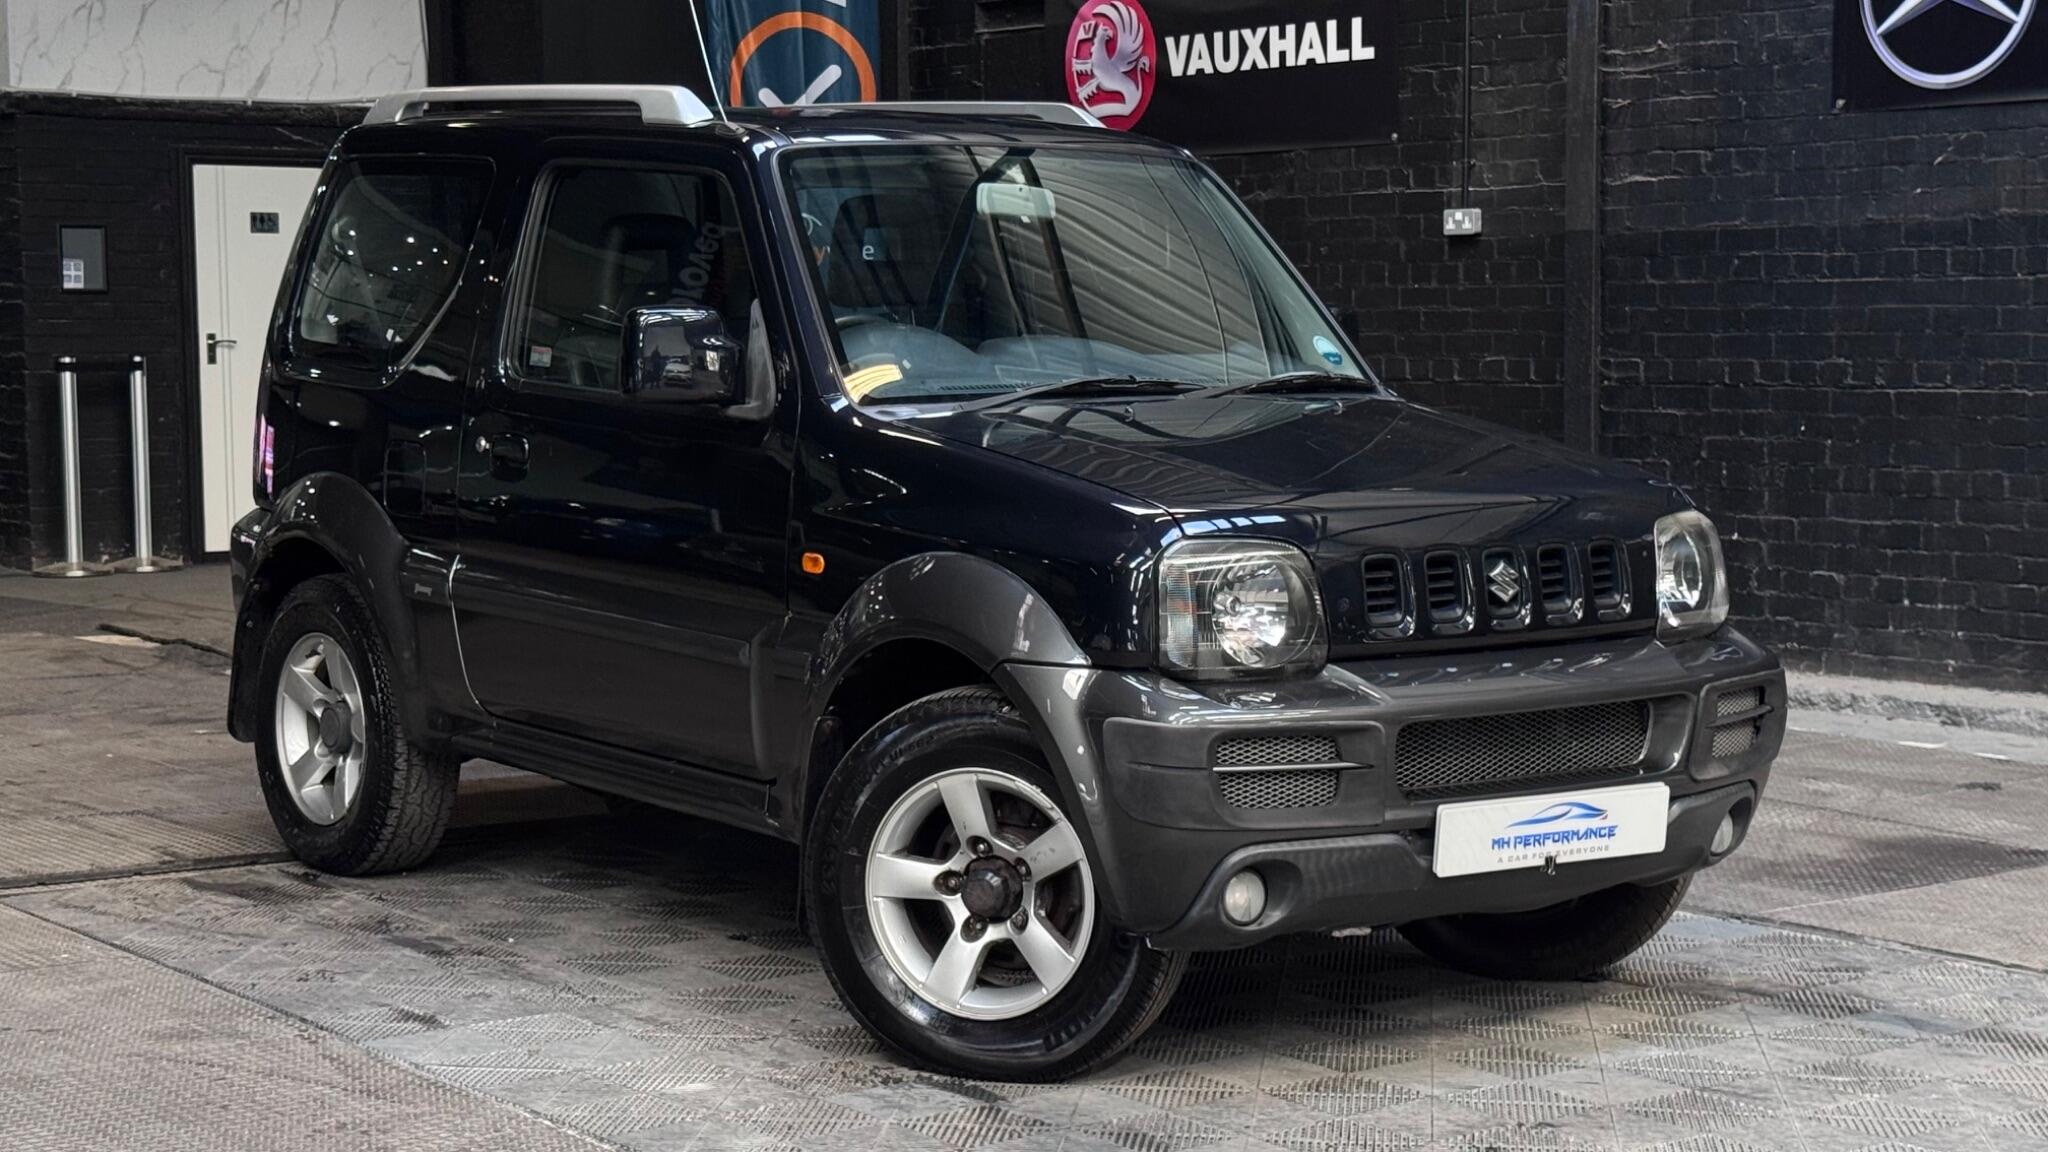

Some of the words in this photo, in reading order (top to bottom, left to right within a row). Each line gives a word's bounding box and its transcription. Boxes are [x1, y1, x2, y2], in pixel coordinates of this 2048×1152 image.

[1165, 17, 1375, 77] VAUXHALL
[1491, 837, 1511, 851] MH
[1513, 825, 1618, 850] PERFORMANCE
[1507, 854, 1528, 863] CAR
[1556, 844, 1610, 857] EVERYONE
